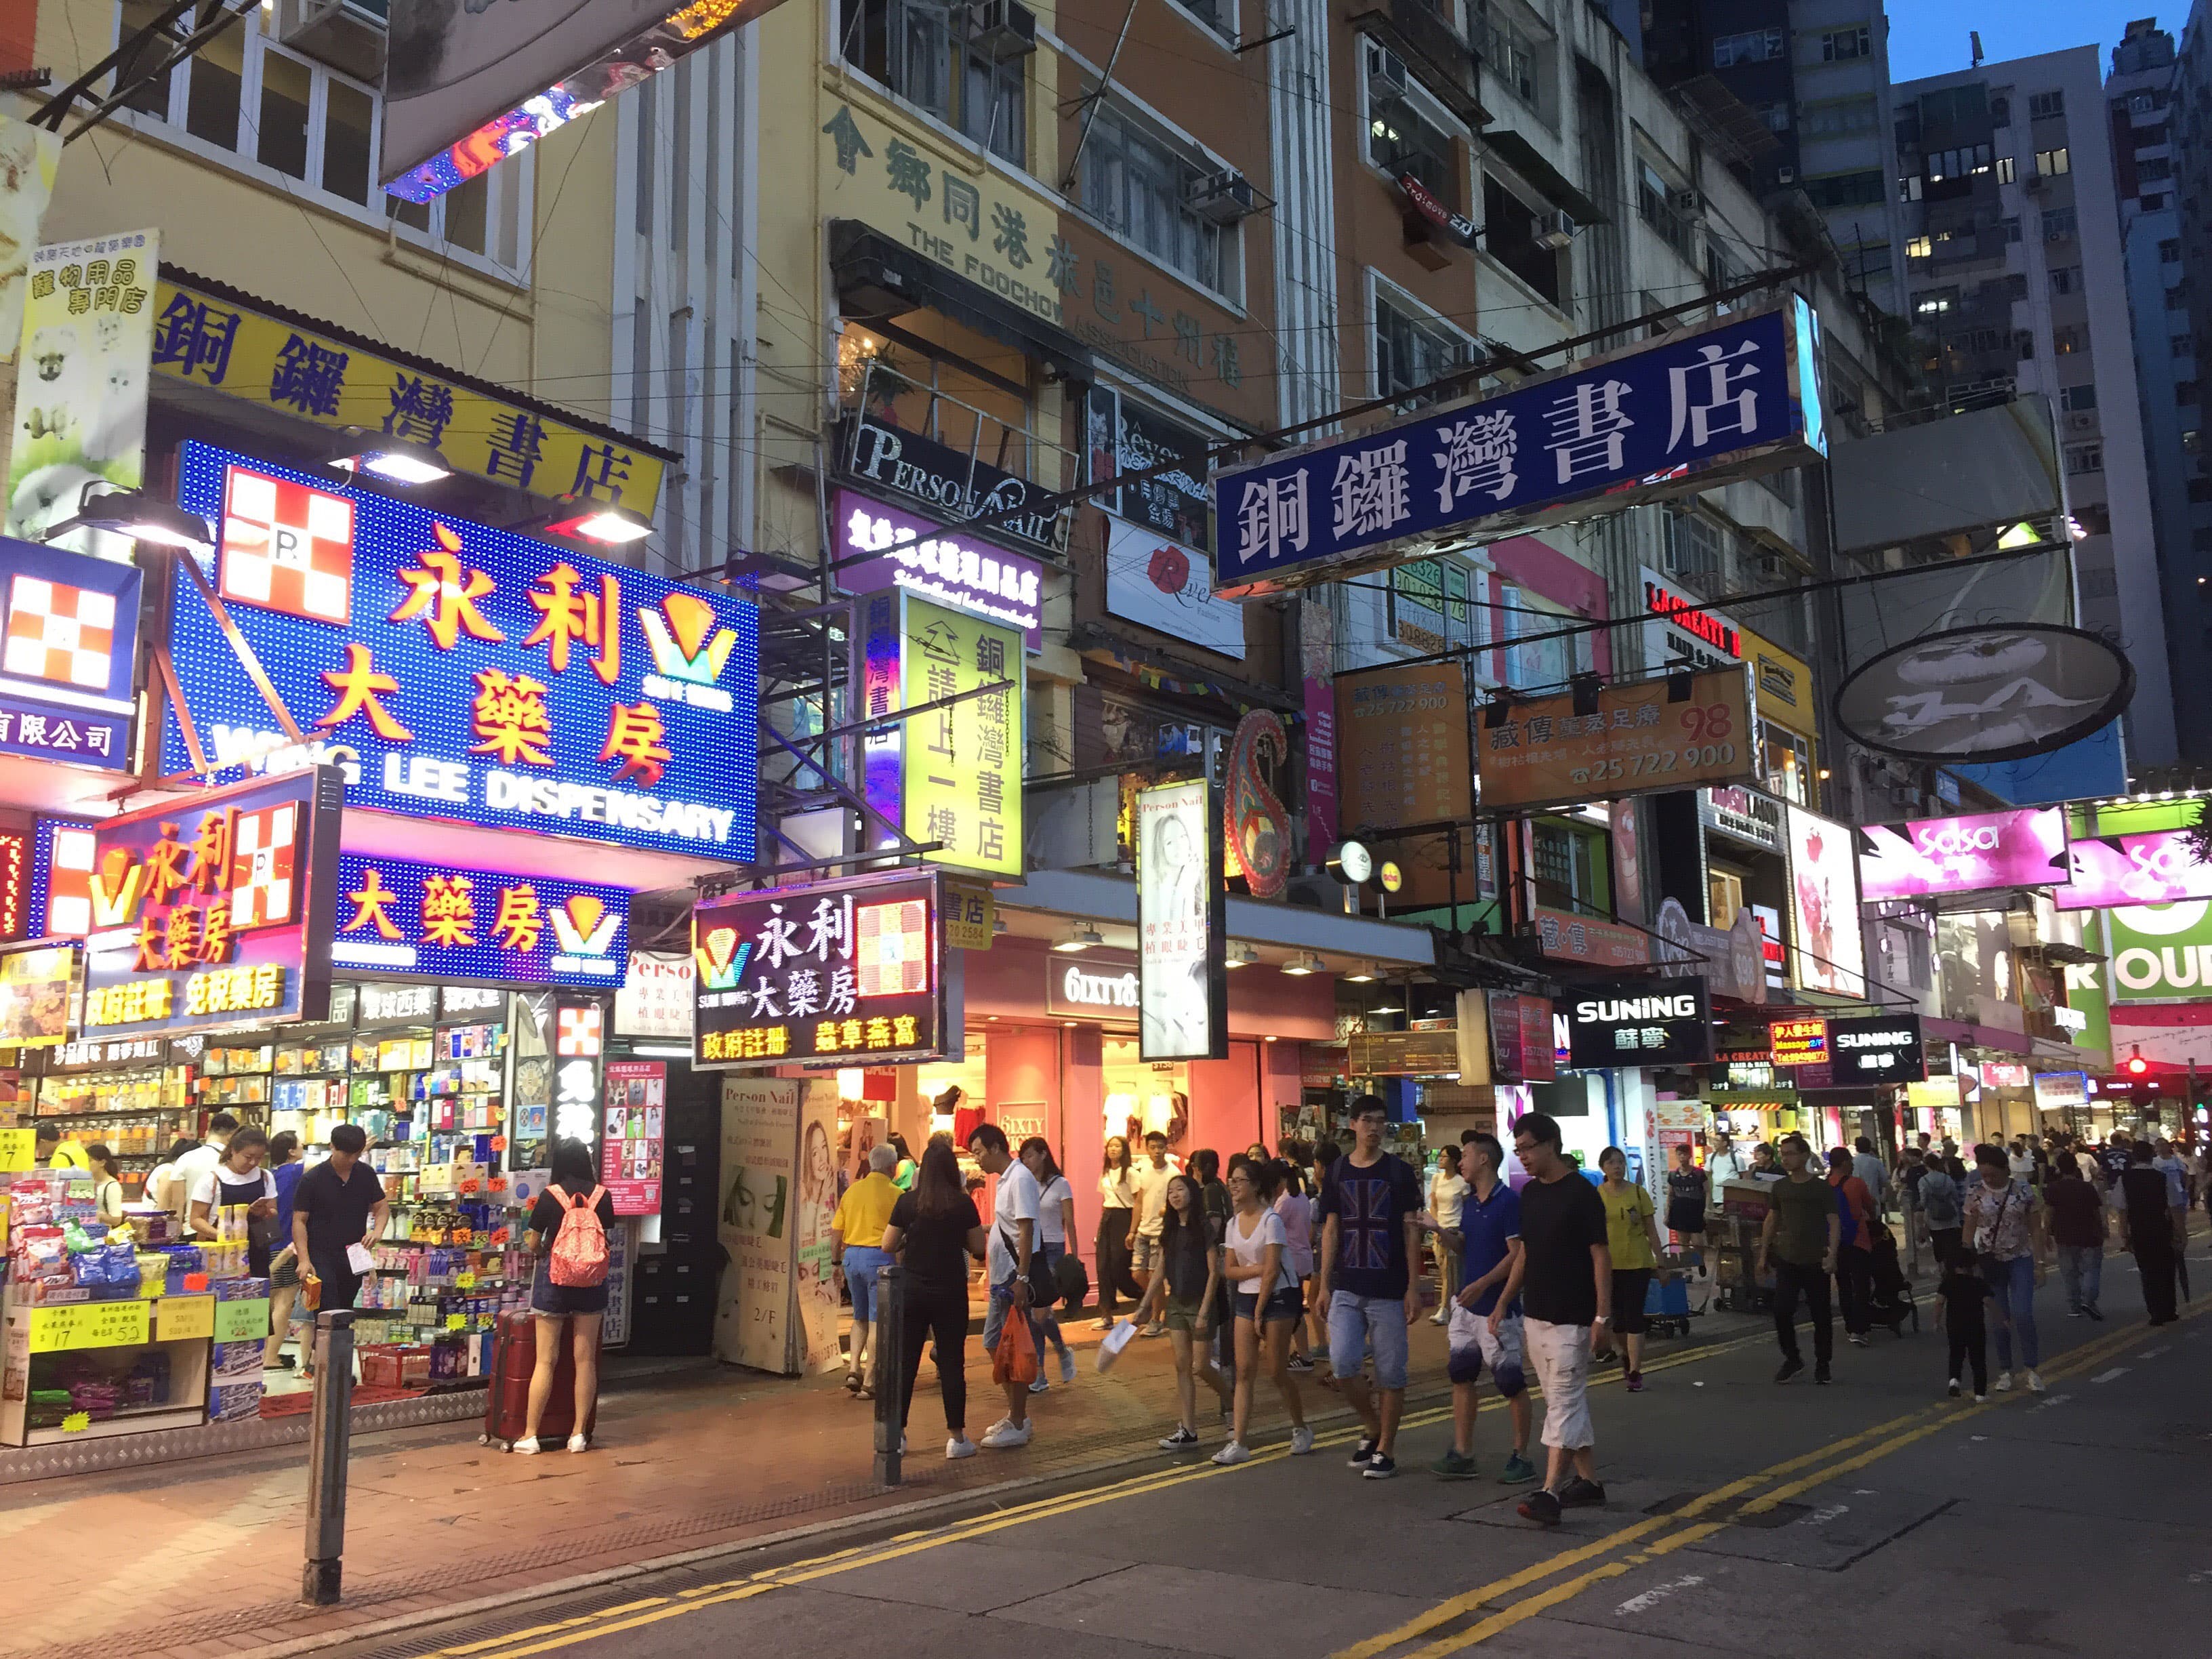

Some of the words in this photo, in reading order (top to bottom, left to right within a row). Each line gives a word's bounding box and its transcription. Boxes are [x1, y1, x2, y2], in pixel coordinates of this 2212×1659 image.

[32, 259, 136, 300] 寵物用品
[907, 221, 954, 266] THE
[964, 253, 1064, 325] FOOCHOW
[68, 287, 148, 314] 專門店
[153, 292, 633, 506] 銅鑼灣書店
[1237, 339, 1760, 565] 銅鑼灣書店
[387, 520, 622, 685] 永利
[314, 642, 673, 789] 大藥房
[1389, 699, 1415, 714] 722
[1419, 696, 1448, 711] 900
[1680, 703, 1732, 743] 98
[0, 707, 112, 756] 有限公司
[977, 634, 1006, 862] 銅鑼灣書店
[927, 664, 957, 853] 請上一樓
[1593, 758, 1626, 782] 25
[1632, 750, 1679, 776] 722
[1683, 743, 1735, 770] 900
[384, 753, 469, 802] LEE
[486, 771, 735, 843] DISPENSARY
[1143, 800, 1179, 813] Person
[1182, 796, 1203, 807] Nail
[142, 806, 242, 905] 永利
[344, 868, 544, 952] 大藥房
[945, 892, 984, 924] 書店
[131, 899, 230, 972] 大藥房
[754, 894, 854, 969] 永利
[962, 926, 984, 939] 2584
[752, 965, 858, 1018] 大藥房
[1576, 995, 1696, 1023] SUNING
[702, 1024, 790, 1059] 政府註冊
[815, 1015, 918, 1051] 蟲草燕窩
[1837, 1031, 1912, 1048] SUNING
[1715, 1053, 1729, 1062] LA
[1732, 1051, 1774, 1062] CREATI
[726, 1088, 766, 1103] Person
[770, 1088, 795, 1105] Nail
[1000, 1115, 1045, 1136] 6IXTY
[115, 1326, 140, 1342] 52
[754, 1307, 776, 1324] 2/F
[54, 1330, 70, 1347] 17
